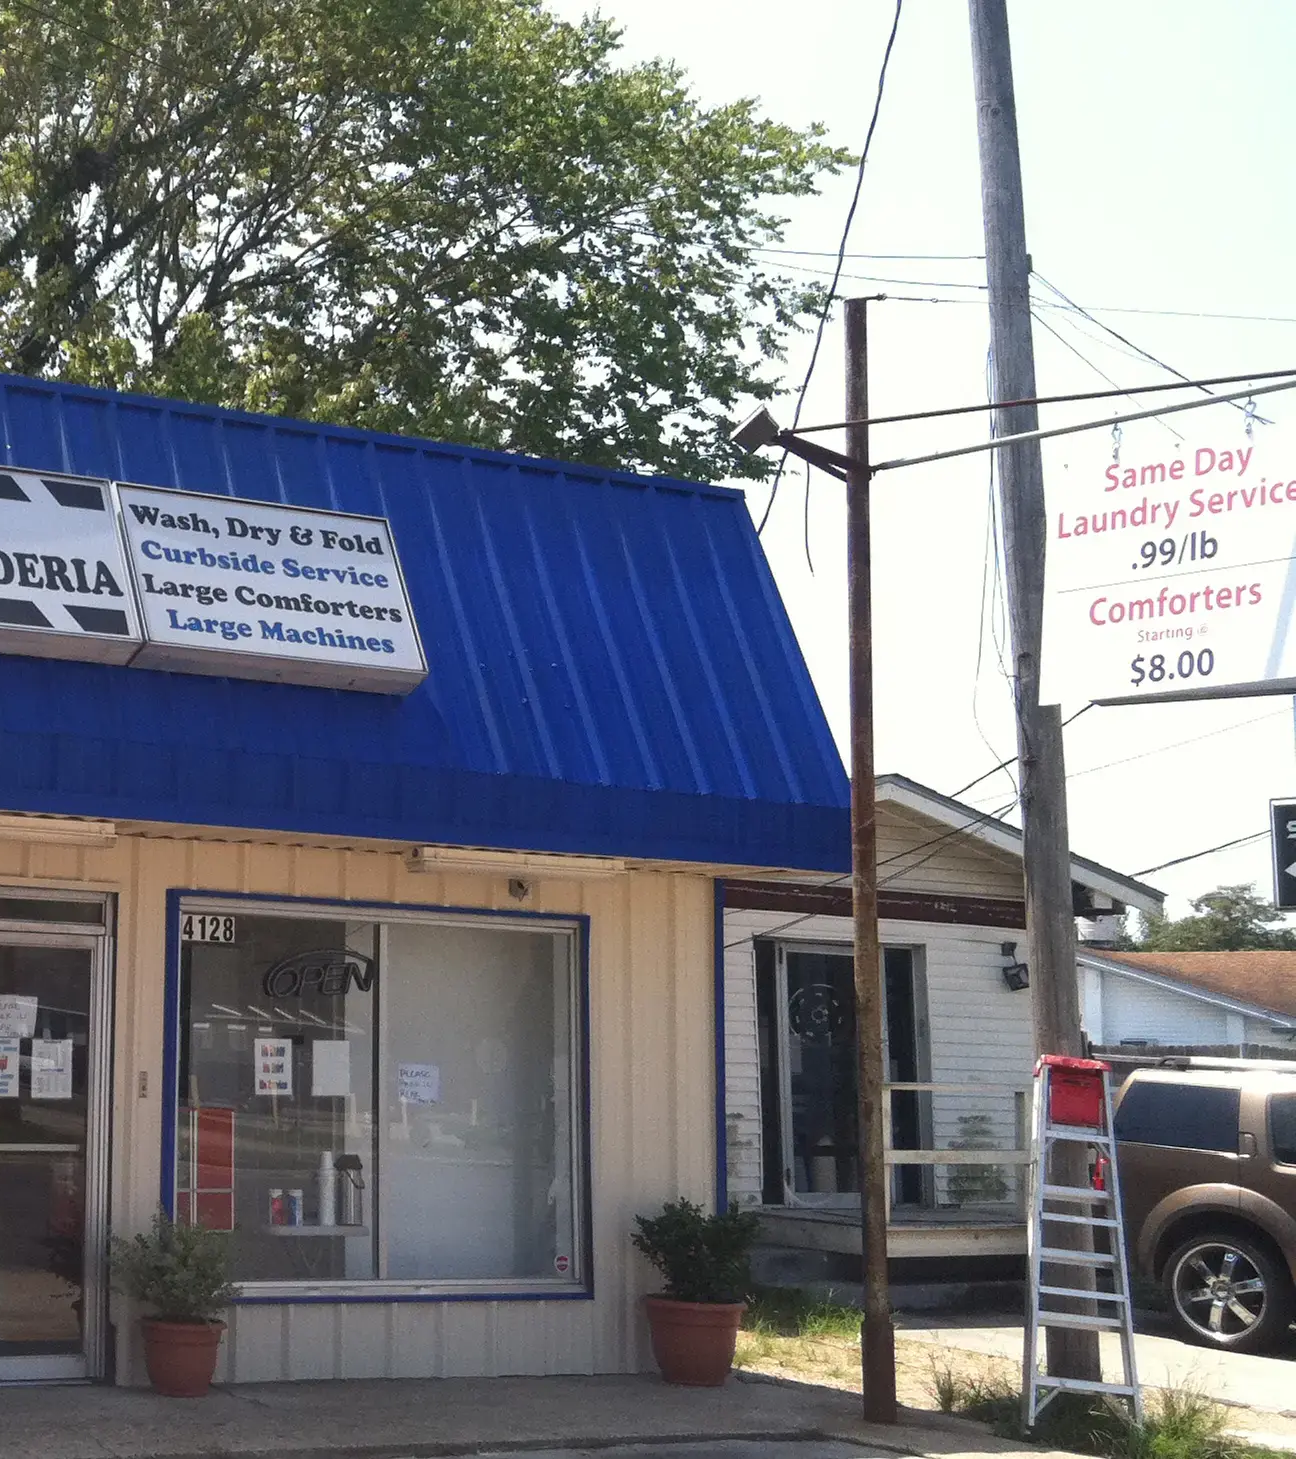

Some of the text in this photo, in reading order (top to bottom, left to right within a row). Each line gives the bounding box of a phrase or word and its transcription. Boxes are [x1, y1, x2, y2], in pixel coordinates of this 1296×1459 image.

[1104, 446, 1253, 492] Same Day
[129, 503, 384, 556] Wash, Dry & Fold
[1058, 477, 1296, 539] Laundry Service
[140, 540, 389, 588] Curbside Service
[1131, 531, 1219, 570] .99/lb
[142, 573, 403, 622] Large Comforters
[1089, 582, 1262, 626] Comforters
[166, 609, 395, 653] Large Machines
[1137, 626, 1193, 643] Starting
[1131, 648, 1215, 687] $8.00
[183, 916, 234, 941] 4128
[271, 961, 375, 999] OPEN
